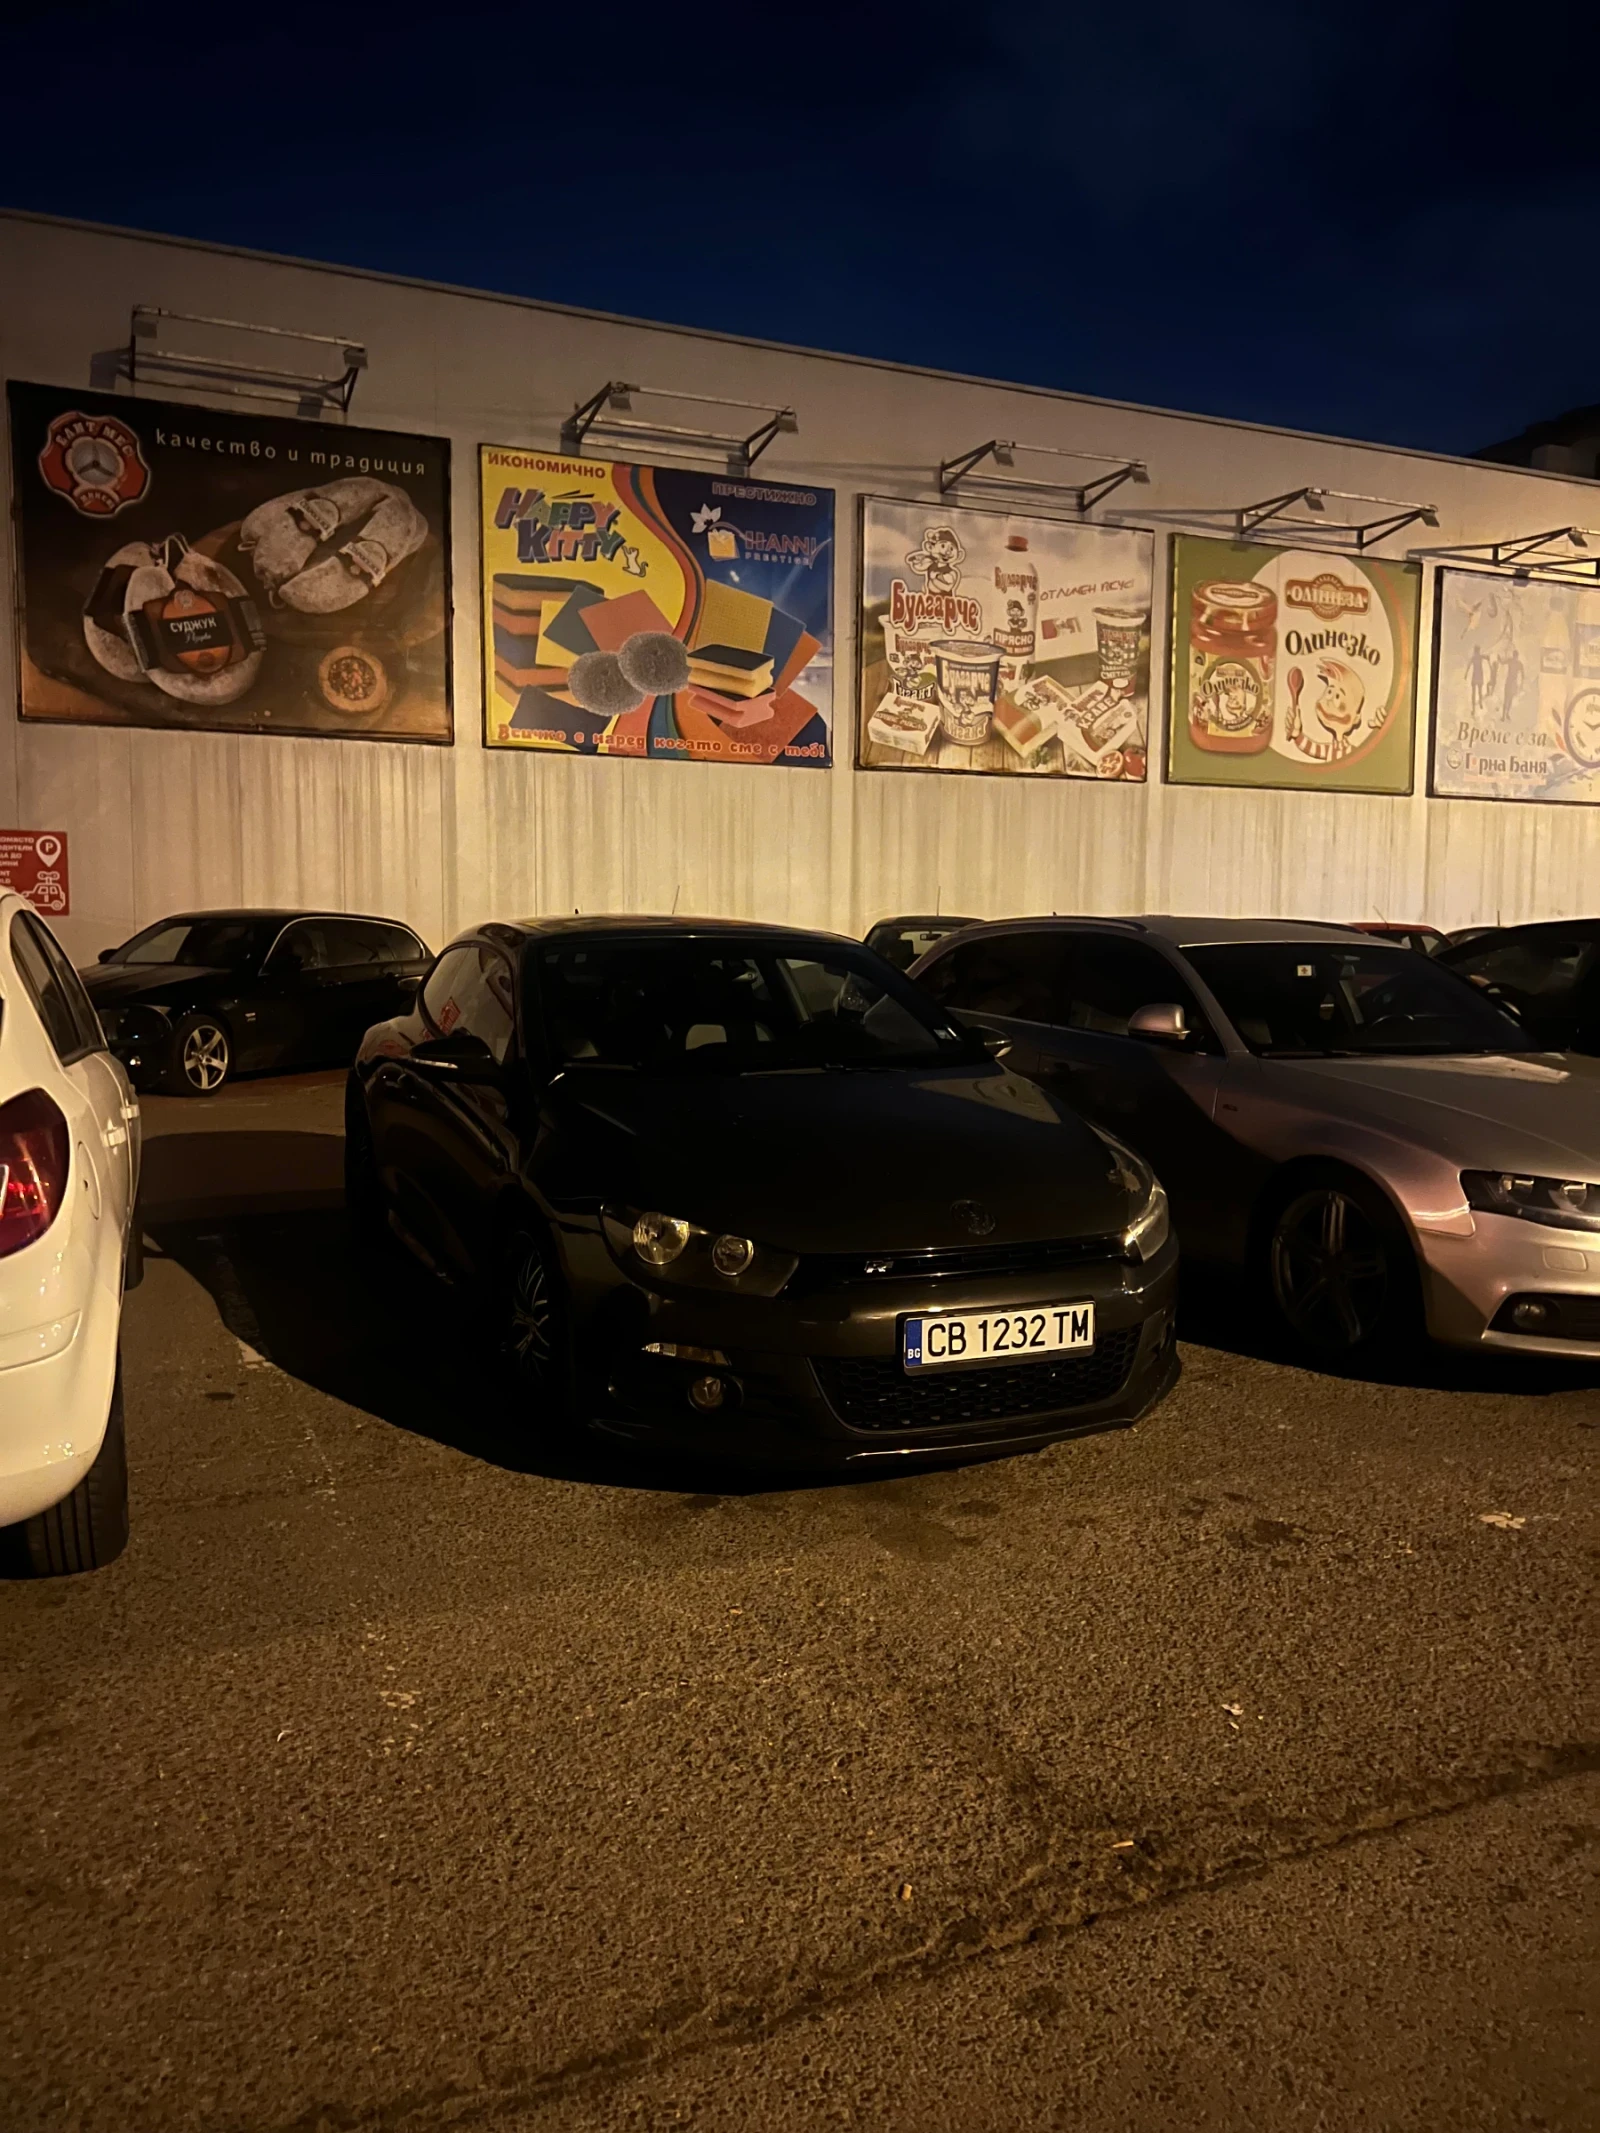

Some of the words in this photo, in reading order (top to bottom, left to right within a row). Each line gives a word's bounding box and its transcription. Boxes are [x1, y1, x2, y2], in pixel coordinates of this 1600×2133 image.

[156, 428, 276, 459] качество
[288, 450, 298, 461] и
[310, 451, 425, 475] традиция
[487, 451, 606, 479] ИКОНОМИЧНО
[712, 481, 817, 506] ПРЕСТИЖНО
[170, 616, 217, 633] СУДЖУК
[995, 632, 1034, 648] ПРЯСНО
[498, 723, 566, 742] Всичко
[573, 731, 585, 744] е
[592, 732, 647, 749] наред
[654, 737, 722, 751] когато
[730, 741, 762, 754] сме
[768, 744, 778, 755] с
[927, 1321, 967, 1358] CB
[978, 1314, 1046, 1353] 1232
[1053, 1309, 1089, 1345] TM
[907, 1348, 921, 1359] BG
